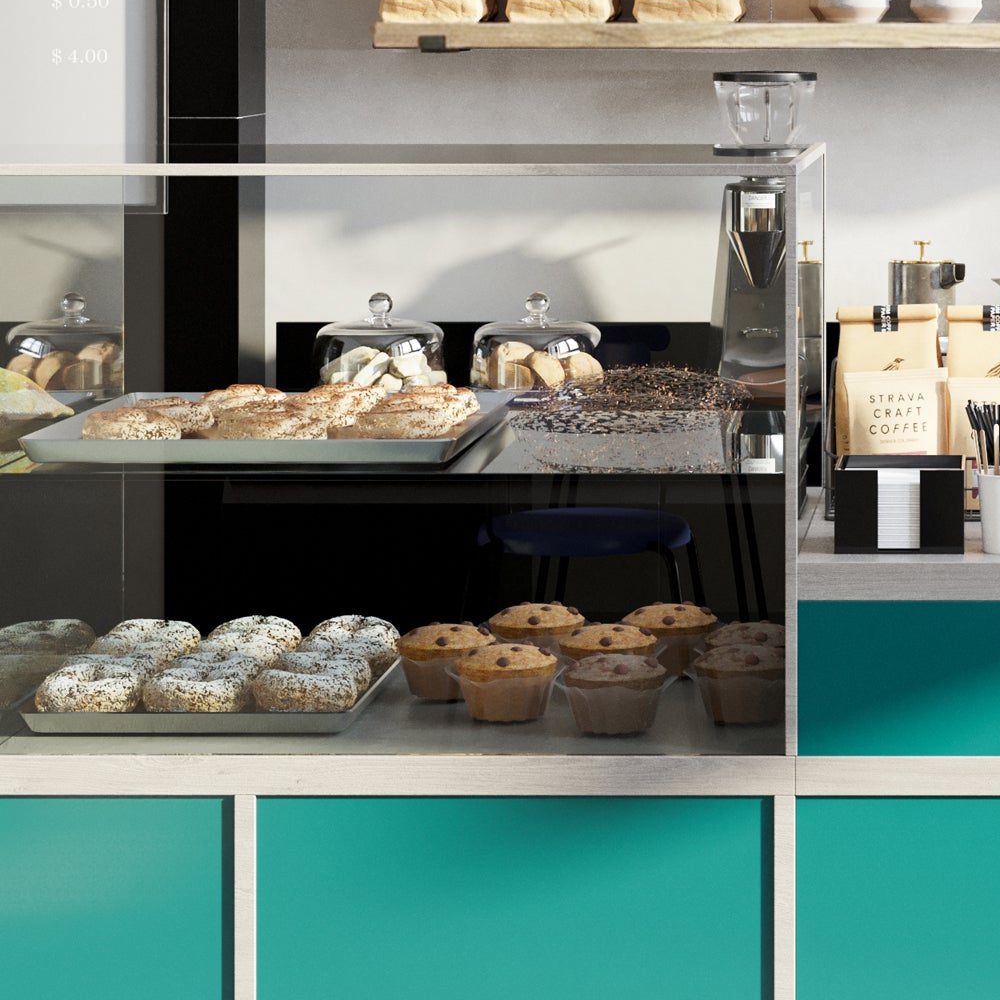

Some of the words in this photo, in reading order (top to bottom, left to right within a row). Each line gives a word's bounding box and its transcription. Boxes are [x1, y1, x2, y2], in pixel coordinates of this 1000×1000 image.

[51, 48, 63, 65] $
[68, 49, 108, 64] 4.00
[869, 393, 925, 404] STRAVA
[874, 406, 921, 418] CRAFT
[869, 422, 928, 435] COFFEE
